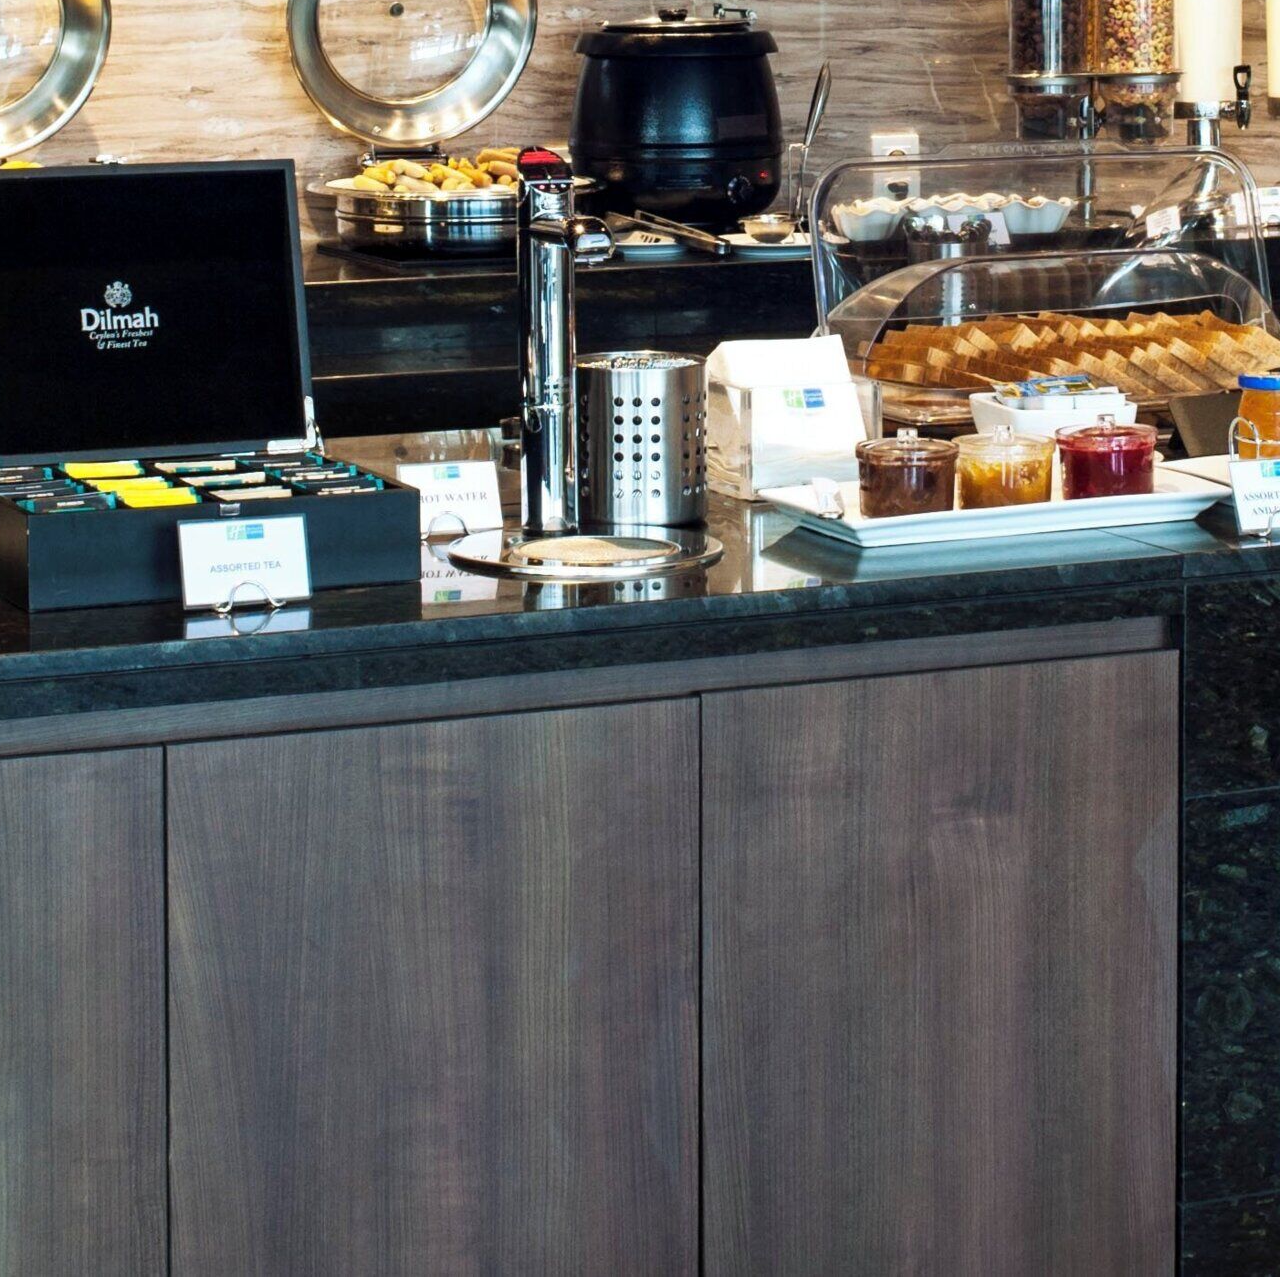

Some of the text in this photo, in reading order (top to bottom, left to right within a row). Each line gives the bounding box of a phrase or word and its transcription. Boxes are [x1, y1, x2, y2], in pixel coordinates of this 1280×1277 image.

[80, 306, 159, 331] Dilmah
[89, 328, 153, 340] Ceylon's Freshest
[106, 339, 131, 350] Finest
[132, 338, 148, 347] Tea
[444, 491, 488, 502] WATER
[1252, 506, 1271, 516] AND
[210, 560, 282, 574] ASSORTED TEA
